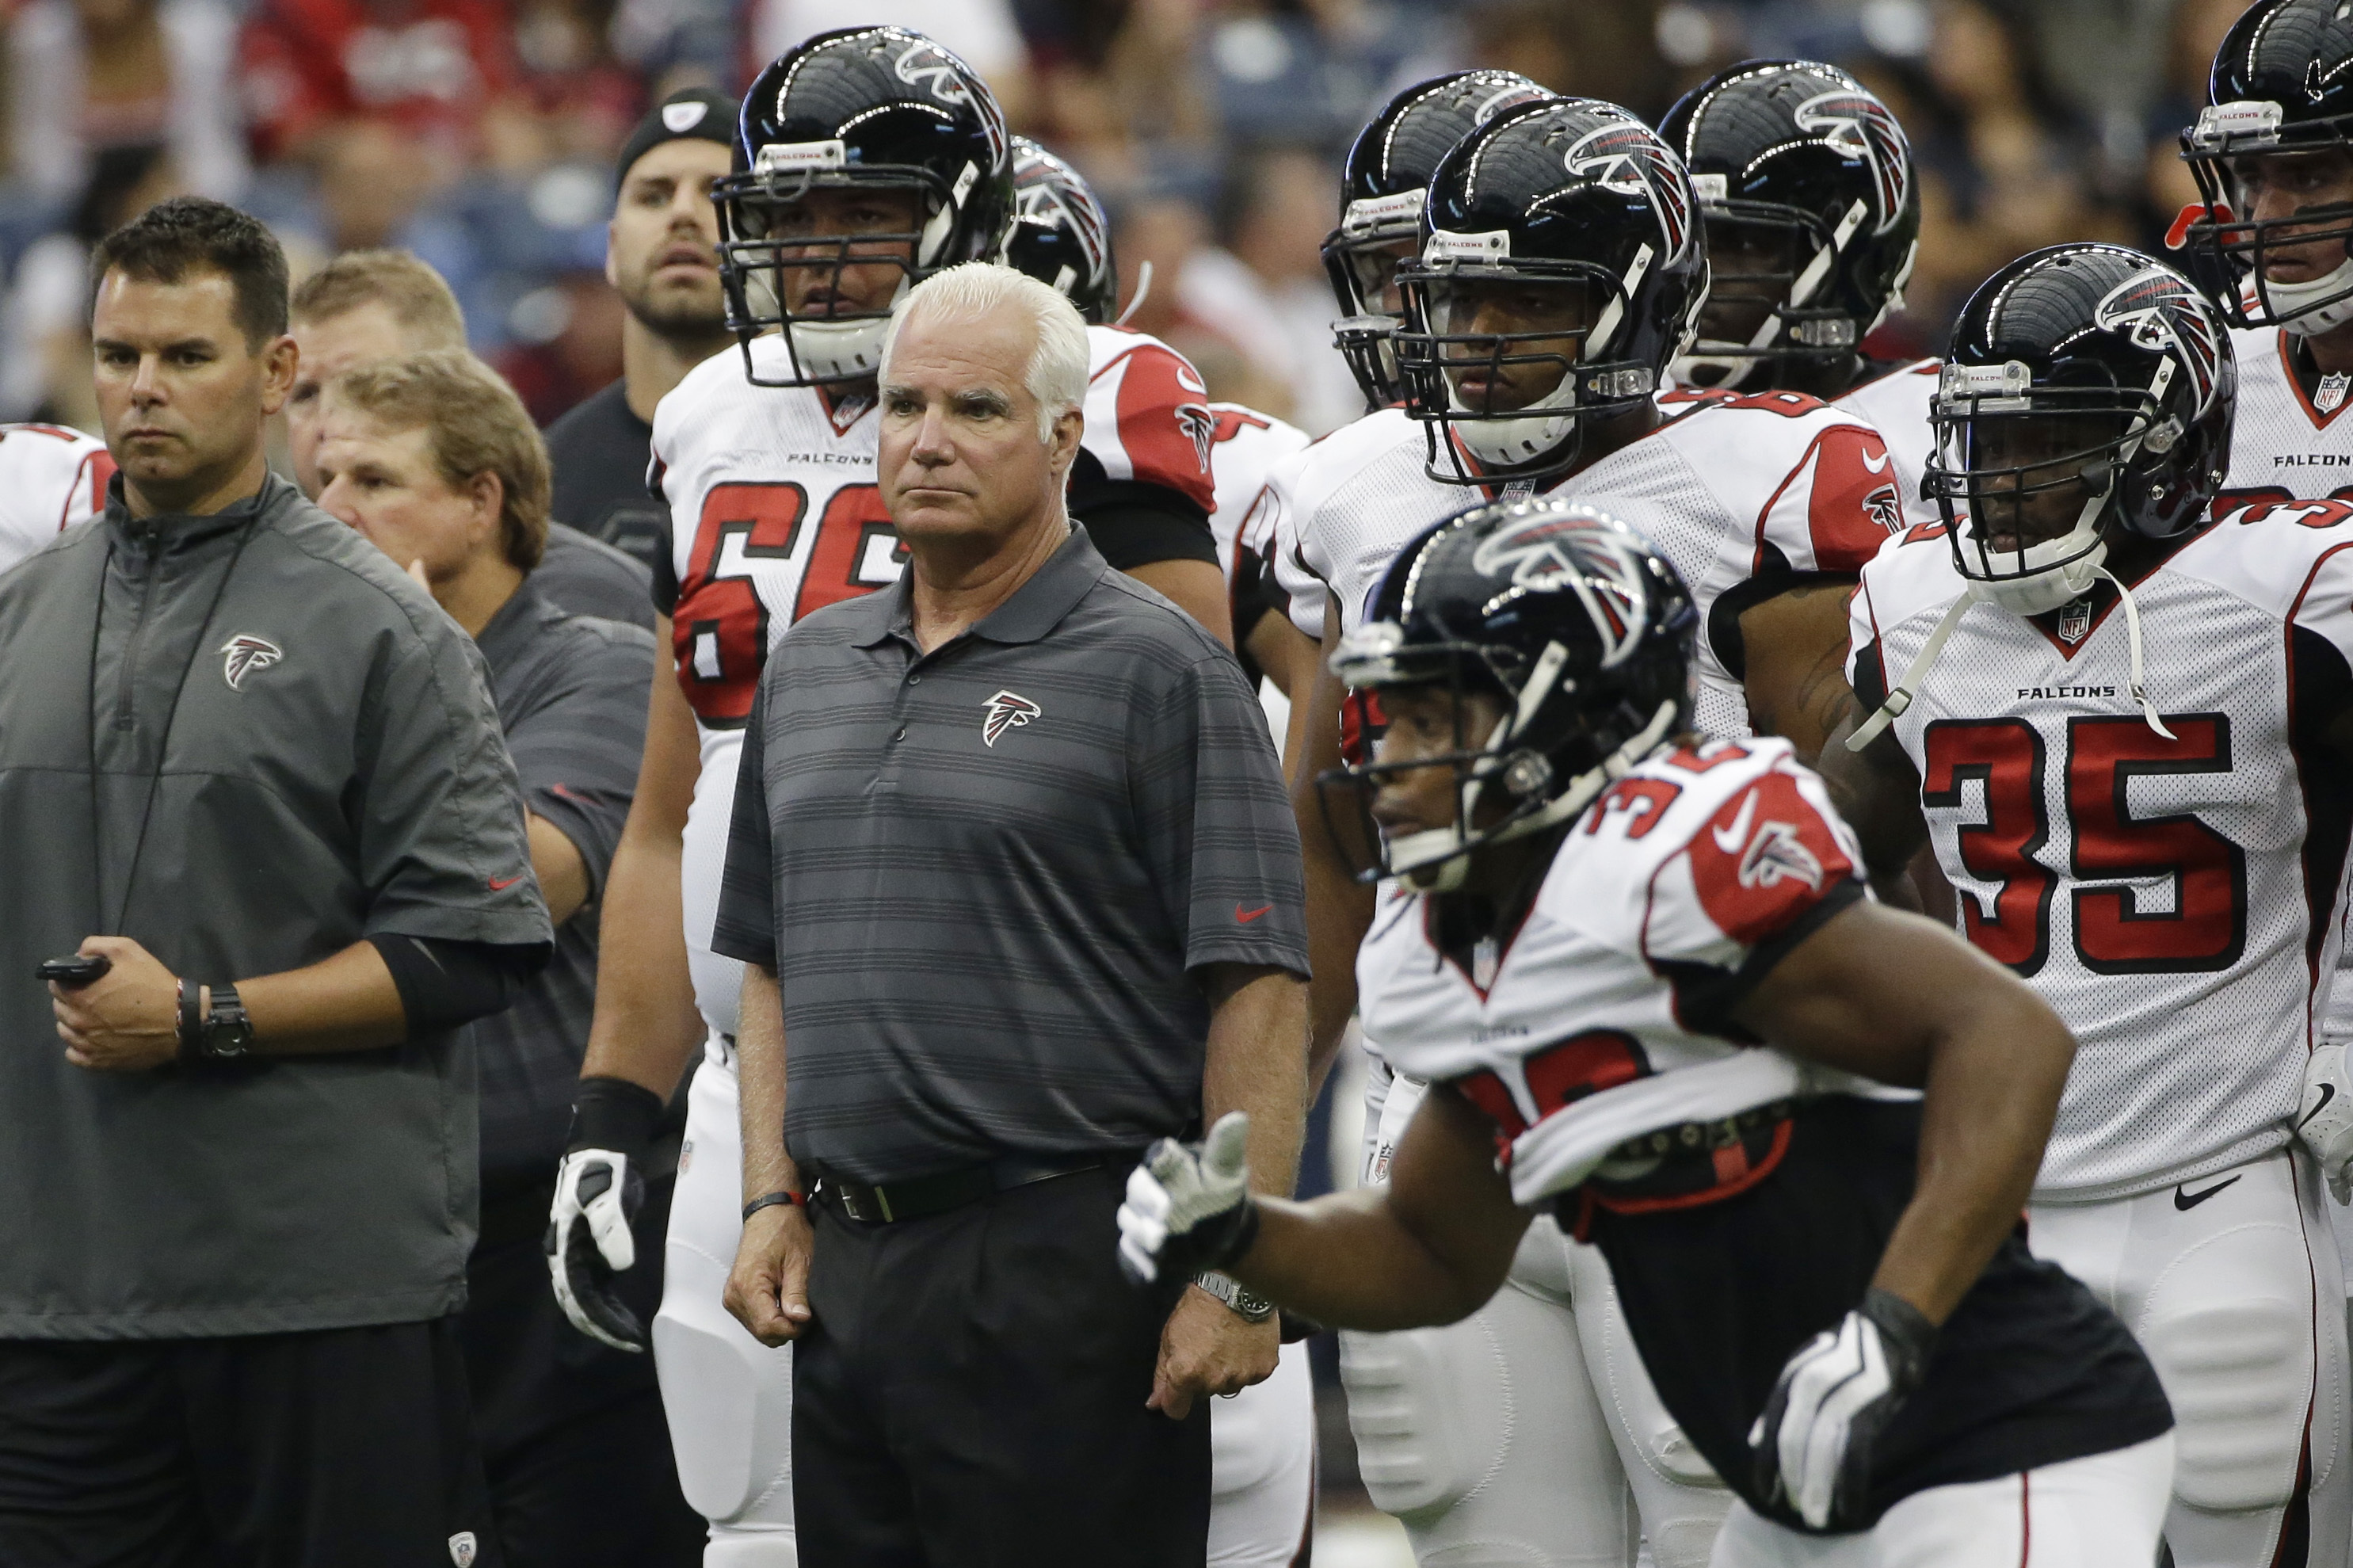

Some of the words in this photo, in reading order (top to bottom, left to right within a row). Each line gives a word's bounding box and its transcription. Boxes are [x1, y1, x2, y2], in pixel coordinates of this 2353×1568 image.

[1363, 204, 1405, 215] FALCONS
[788, 453, 873, 465] FALCONS
[2273, 454, 2353, 467] FALCON
[2064, 618, 2084, 636] NFL
[2017, 686, 2116, 700] FALCONS
[1923, 712, 2248, 979] 35
